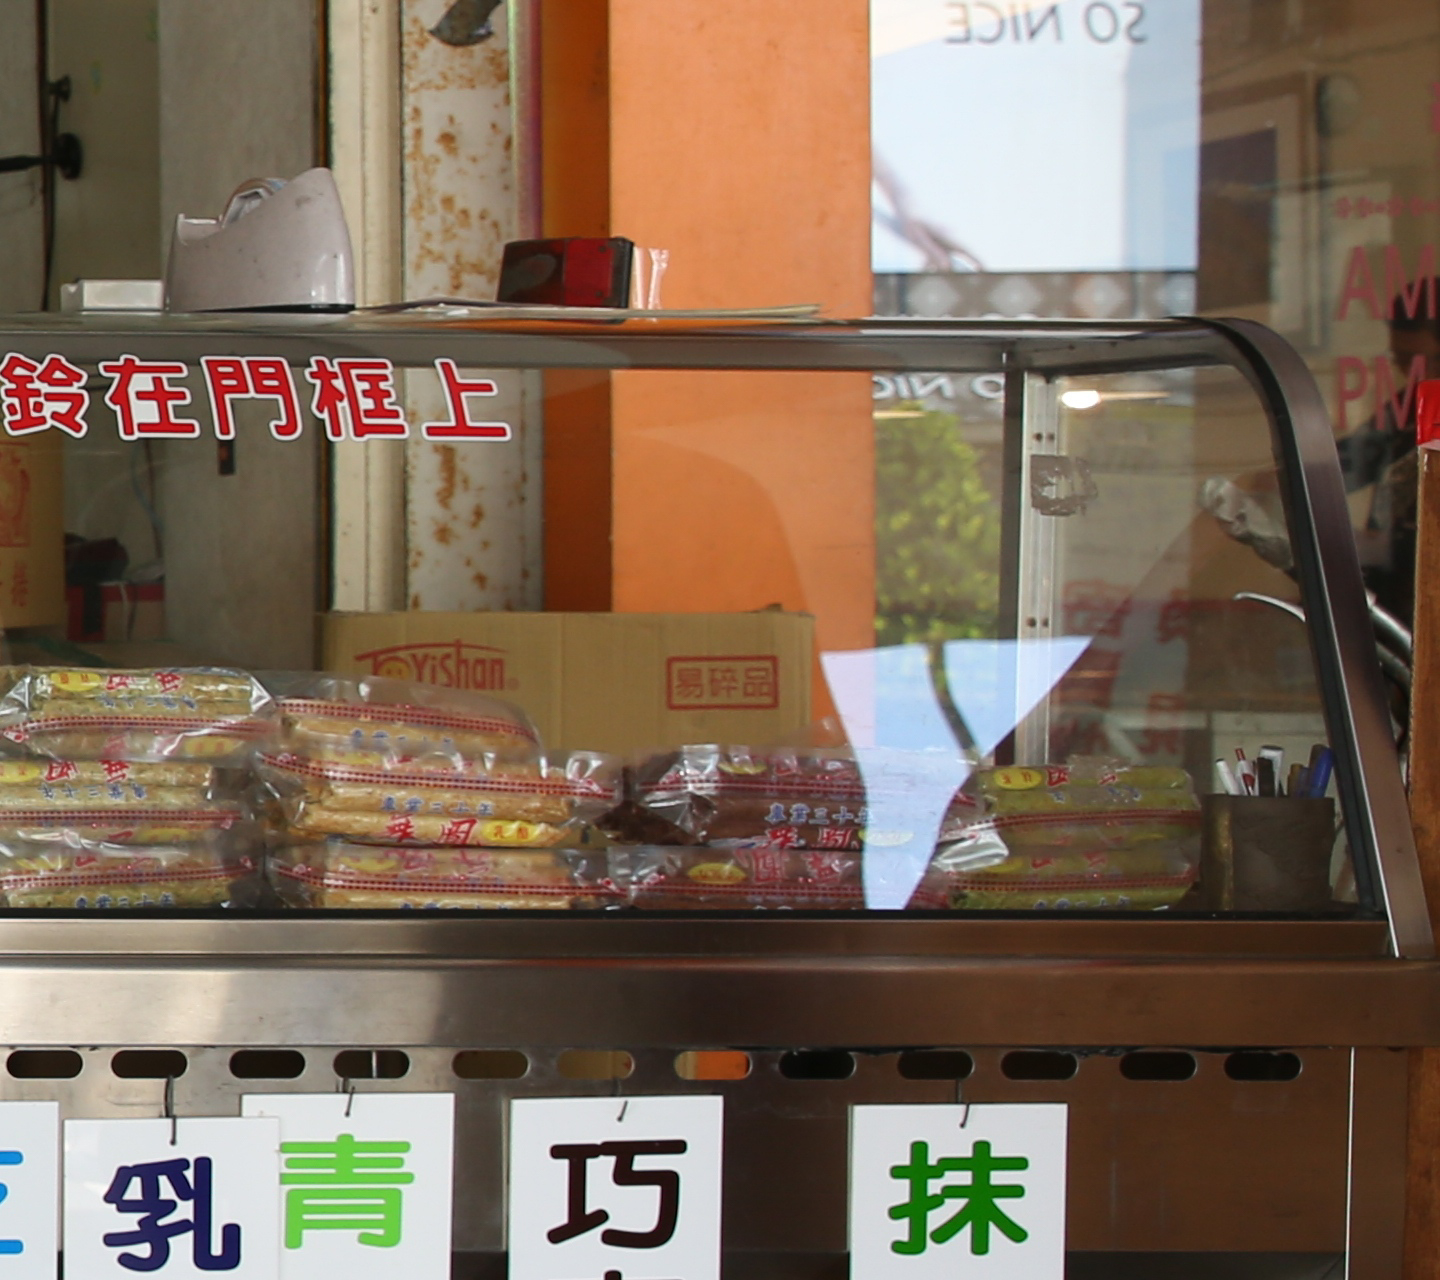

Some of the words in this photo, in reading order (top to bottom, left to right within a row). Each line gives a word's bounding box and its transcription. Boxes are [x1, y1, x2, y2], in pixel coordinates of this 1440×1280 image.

[1337, 243, 1436, 320] AM
[1335, 353, 1427, 432] PM
[676, 666, 774, 699] 易碎品
